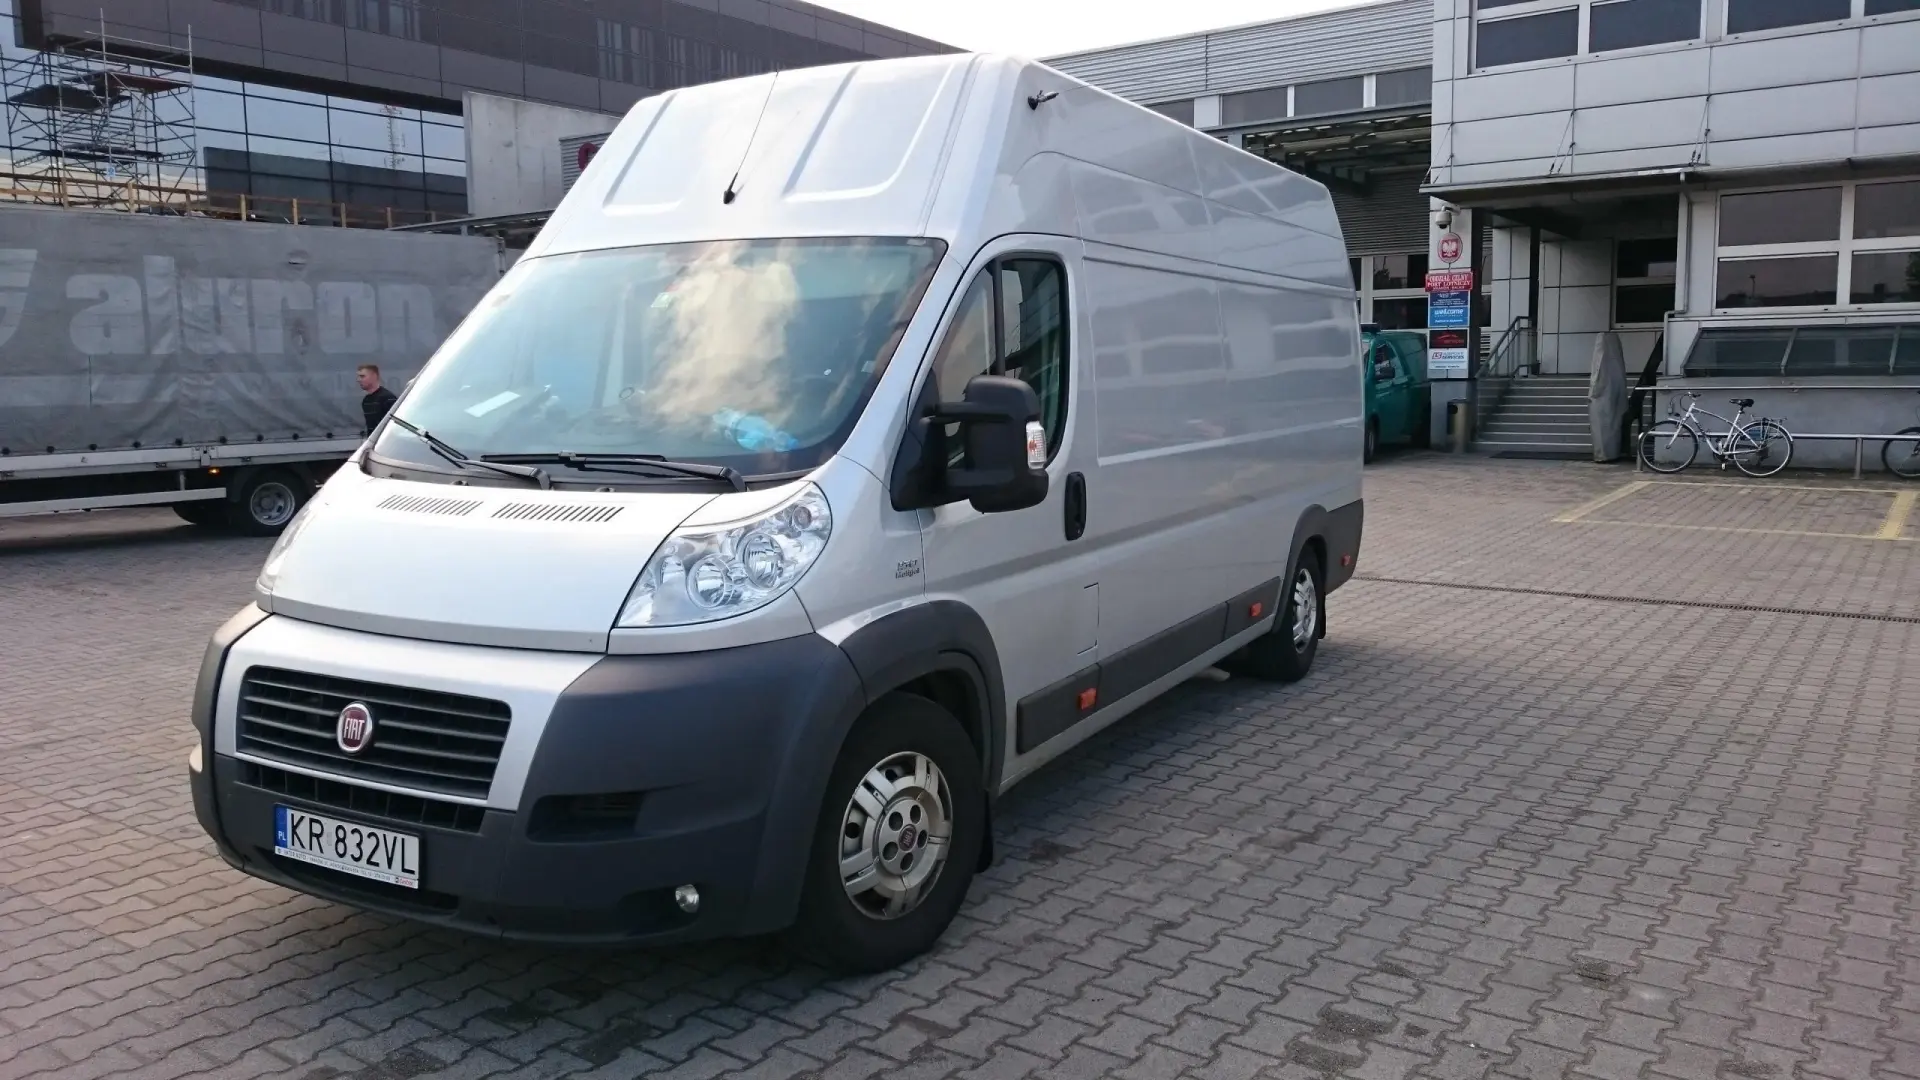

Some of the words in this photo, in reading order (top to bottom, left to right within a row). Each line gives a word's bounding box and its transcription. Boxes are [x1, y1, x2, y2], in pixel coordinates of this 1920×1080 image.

[65, 255, 437, 355] aluron
[344, 718, 365, 740] FIAT
[278, 830, 287, 842] PL
[290, 813, 324, 854] KR
[335, 825, 416, 875] 832VL
